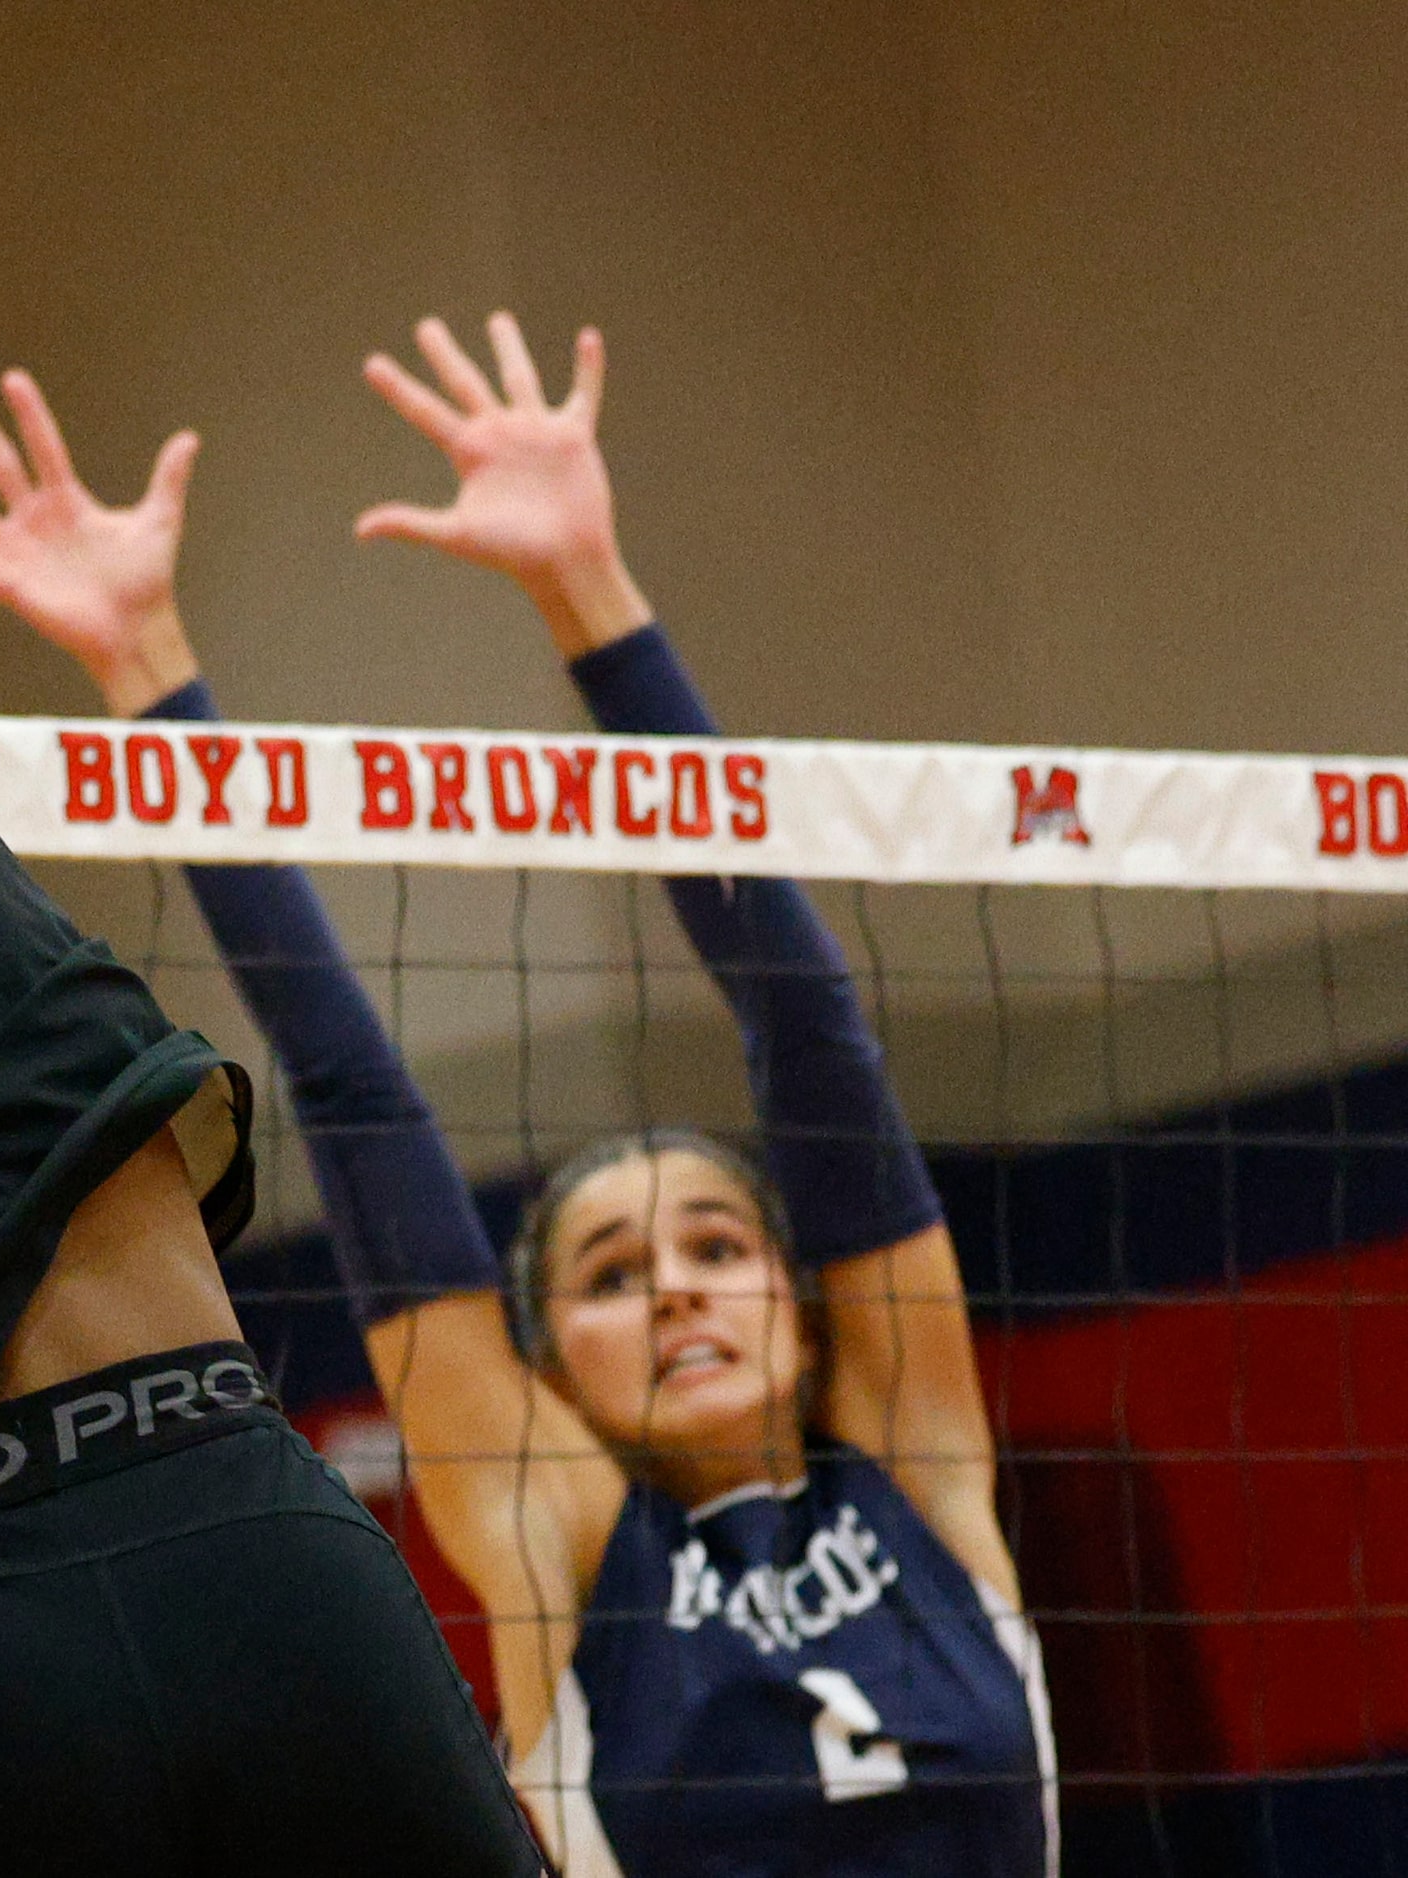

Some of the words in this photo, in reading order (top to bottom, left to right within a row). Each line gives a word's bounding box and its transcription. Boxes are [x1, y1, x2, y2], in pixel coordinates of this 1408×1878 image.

[58, 731, 308, 828] BOYD
[354, 740, 768, 840] BRONCOS
[1314, 770, 1408, 857] BO
[50, 1357, 265, 1465] PRO
[798, 1667, 909, 1802] 2
